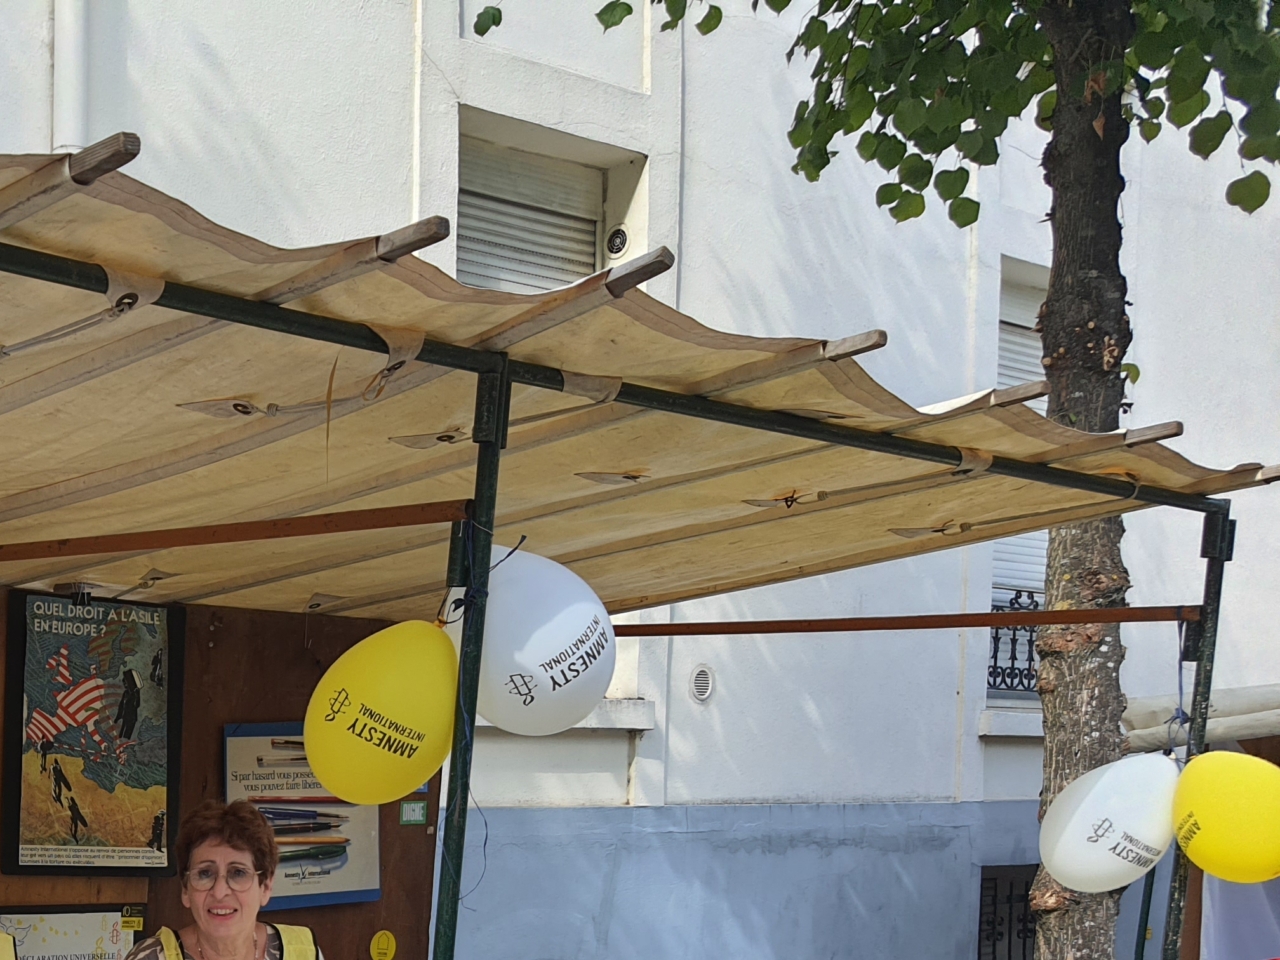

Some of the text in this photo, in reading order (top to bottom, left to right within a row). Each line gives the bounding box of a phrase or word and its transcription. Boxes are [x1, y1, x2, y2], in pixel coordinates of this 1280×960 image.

[33, 601, 65, 617] QUEL
[67, 604, 105, 620] DROIT
[121, 609, 161, 625] L'ASILE
[34, 618, 50, 632] EN
[52, 620, 98, 637] EUROPE
[538, 614, 602, 673] INTERNATIONAL
[550, 627, 609, 692] AMNESTY
[358, 702, 426, 742] INTERNATIONAL
[346, 717, 419, 759] AMNESTY
[239, 772, 251, 783] par
[252, 769, 276, 780] hasard
[276, 772, 292, 780] vous
[243, 783, 260, 792] vous
[260, 783, 285, 793] pouvez
[285, 780, 301, 790] faire
[402, 803, 425, 822] DIGNE
